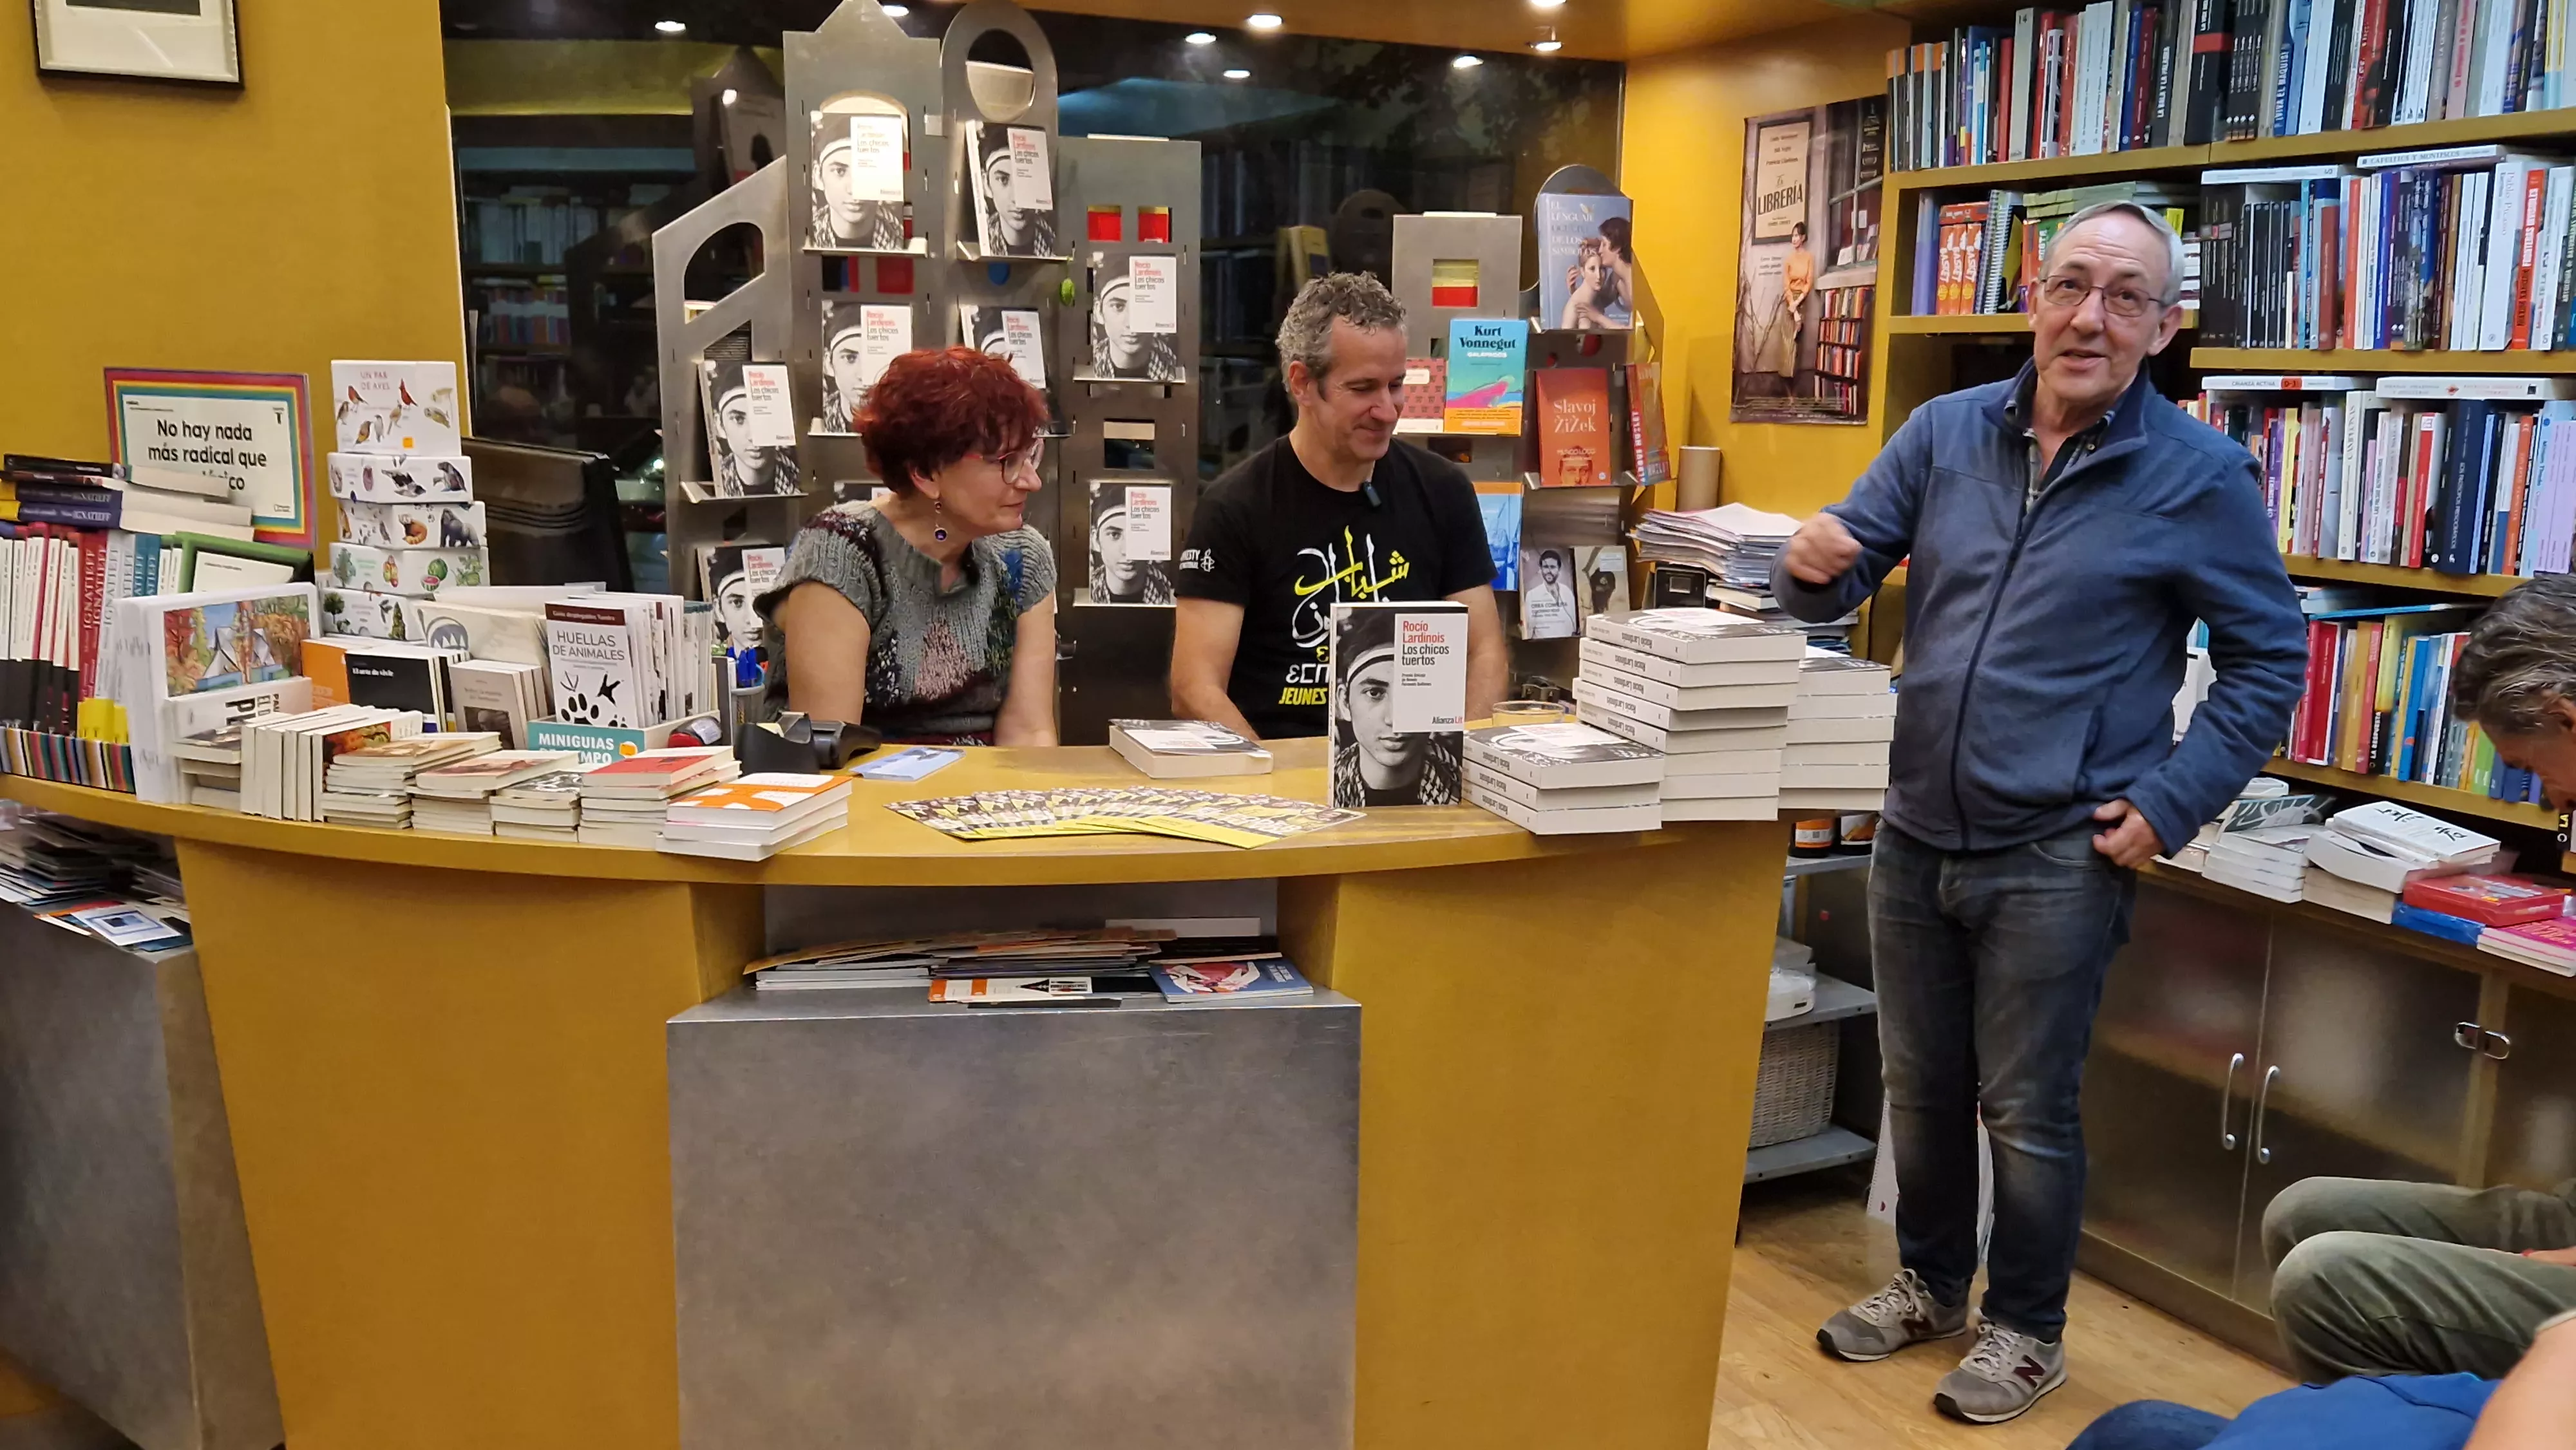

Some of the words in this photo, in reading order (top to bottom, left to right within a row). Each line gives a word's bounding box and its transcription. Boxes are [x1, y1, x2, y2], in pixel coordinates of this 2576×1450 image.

[1757, 180, 1803, 216] LIBRERÍA
[1475, 325, 1502, 336] Kurt
[1459, 337, 1516, 351] Vonnegut
[1553, 399, 1596, 415] Slavoj
[156, 419, 178, 437] No
[182, 420, 211, 441] hay
[215, 422, 252, 441] nada
[147, 442, 178, 462] más
[182, 446, 234, 465] radical
[238, 453, 267, 469] que
[83, 548, 95, 629] IGNATIEFF
[93, 547, 107, 626] IGNATIEFF
[1403, 620, 1428, 632] Rocío
[556, 630, 616, 648] HUELLAS
[1403, 632, 1445, 643] Lardinois
[553, 644, 566, 656] DE
[569, 646, 625, 661] ANIMALES
[1403, 644, 1417, 655] Los
[1419, 643, 1450, 655] chicos
[1401, 655, 1435, 665] tuertos
[1278, 687, 1329, 705] JEUNES
[1432, 716, 1454, 724] Alianza
[538, 733, 614, 751] MINIGUIAS
